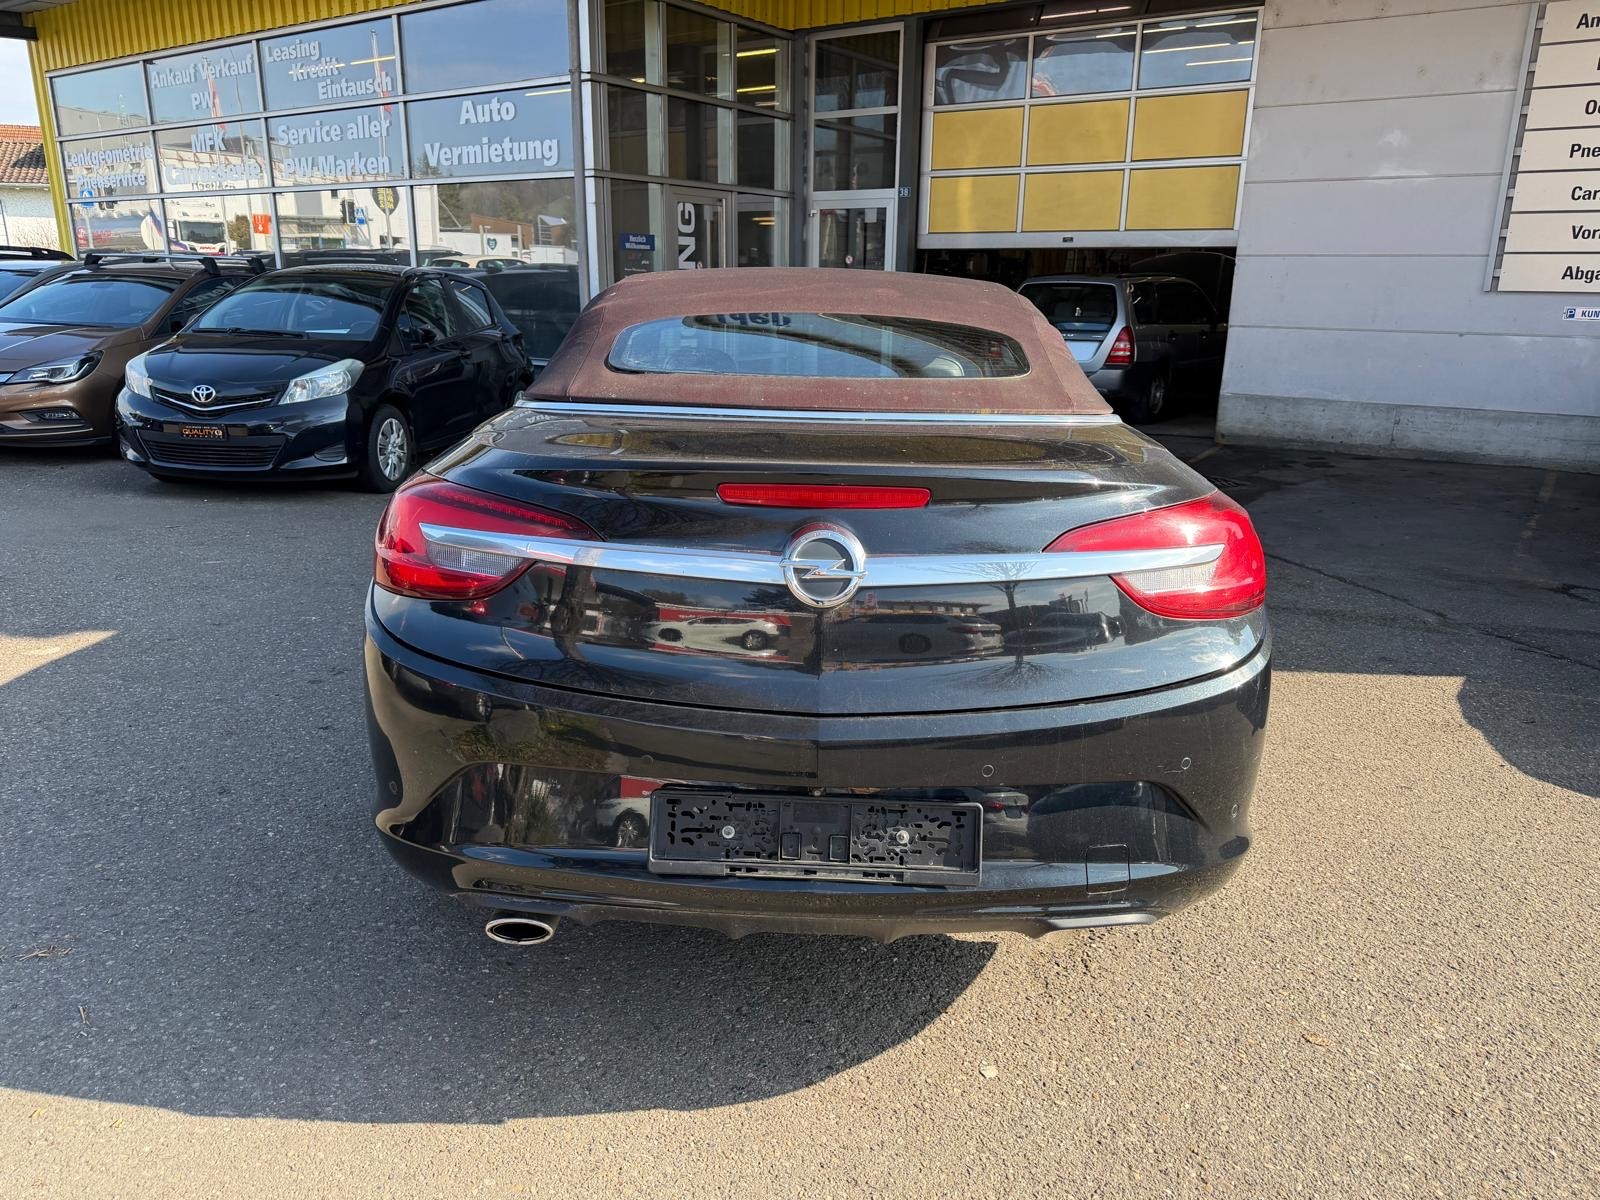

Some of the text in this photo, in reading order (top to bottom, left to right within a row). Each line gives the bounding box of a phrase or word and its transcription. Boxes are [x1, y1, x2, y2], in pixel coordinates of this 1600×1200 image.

[264, 39, 320, 61] Leasing
[151, 54, 254, 89] Ankauf Verkauf
[291, 57, 340, 82] Kredit
[318, 72, 392, 100] Eintausch
[459, 97, 516, 125] Auto
[1585, 99, 1600, 115] O
[191, 130, 226, 152] MFK
[279, 114, 391, 146] Service aller
[64, 143, 152, 169] Lenkgeometrie
[318, 152, 390, 178] Marken
[424, 137, 559, 167] Vermietung
[1571, 186, 1600, 201] Car
[1571, 225, 1600, 240] Vor
